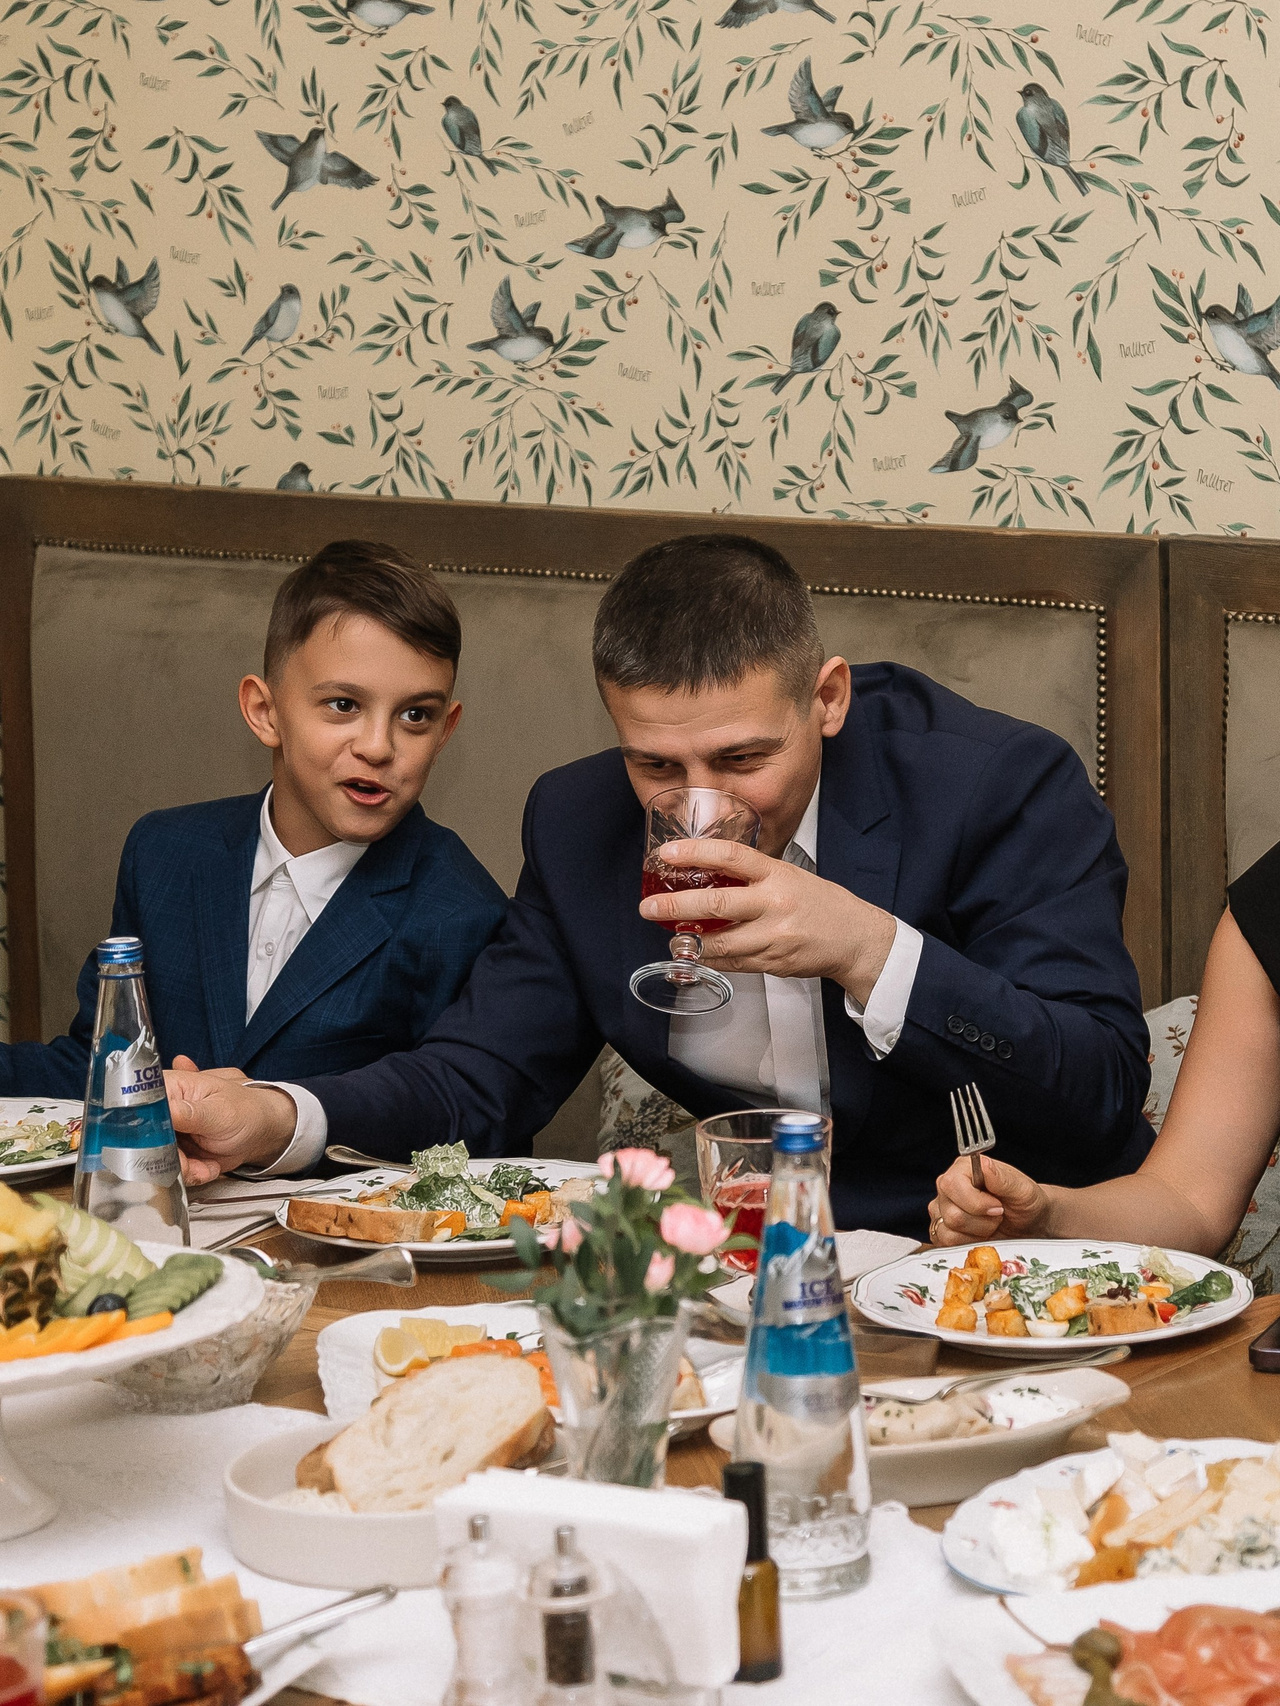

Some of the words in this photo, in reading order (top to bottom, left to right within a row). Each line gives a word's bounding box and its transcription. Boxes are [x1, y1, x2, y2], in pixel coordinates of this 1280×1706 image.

[133, 1064, 161, 1083] ICE
[120, 1078, 165, 1095] MOUNTA
[799, 1277, 836, 1299] ICE
